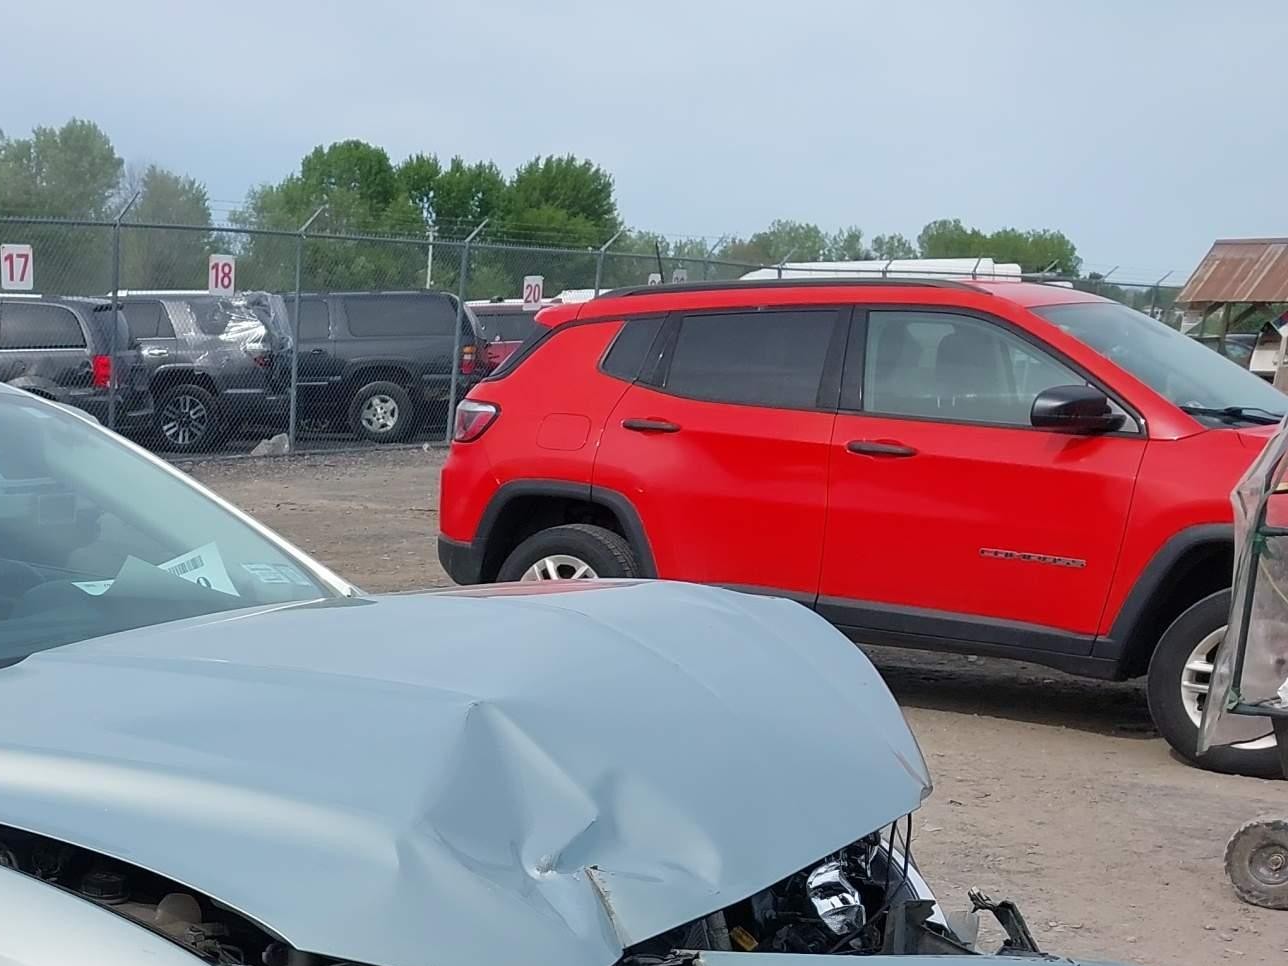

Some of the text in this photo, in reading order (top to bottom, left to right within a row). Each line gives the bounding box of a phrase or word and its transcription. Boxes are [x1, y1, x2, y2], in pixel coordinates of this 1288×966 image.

[4, 253, 29, 282] 17
[211, 262, 232, 289] 18
[524, 283, 541, 303] 20
